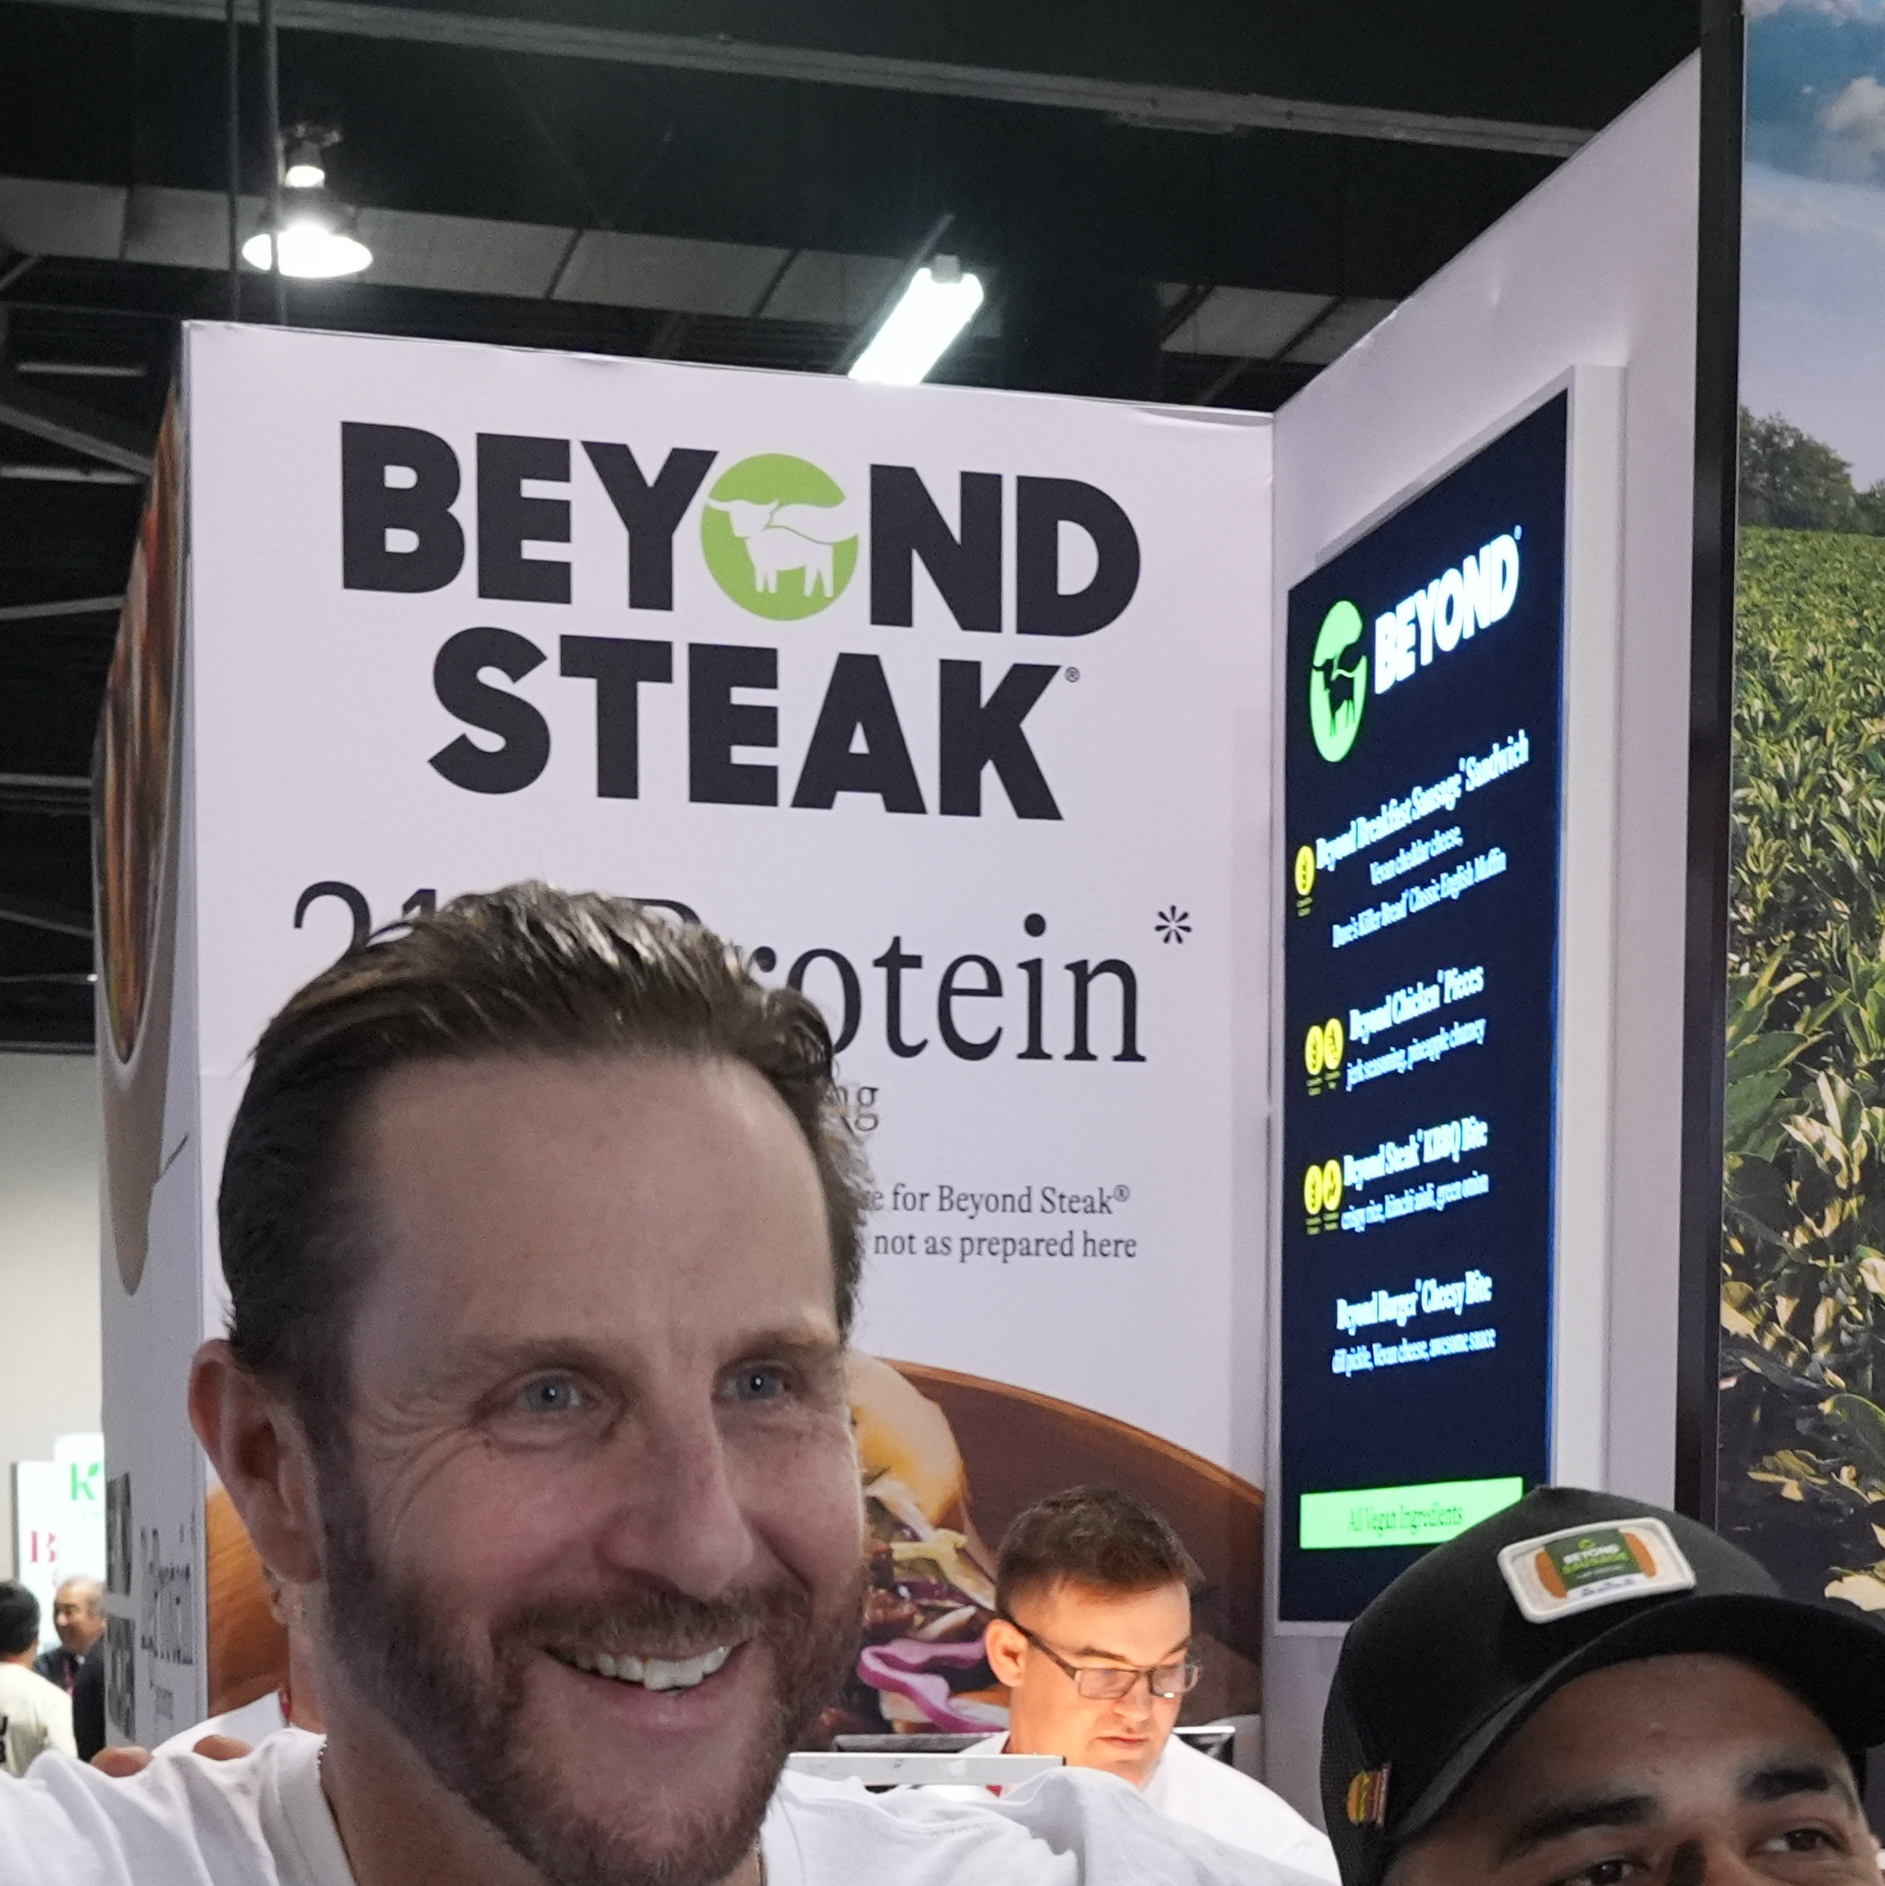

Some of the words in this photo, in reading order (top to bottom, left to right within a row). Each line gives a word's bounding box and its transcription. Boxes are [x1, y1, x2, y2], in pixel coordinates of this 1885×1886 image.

[340, 421, 1141, 638] BEYOND
[1375, 533, 1519, 695] BEYOND
[1315, 820, 1355, 872] Beyond
[1465, 729, 1529, 791] Sandwich
[1349, 995, 1391, 1044] Beyond
[1343, 1144, 1385, 1191] Beyond
[892, 1183, 930, 1212] for
[937, 1185, 1033, 1219] Beyond
[874, 1232, 917, 1256] not
[924, 1235, 951, 1256] as
[960, 1230, 1074, 1263] prepared
[1083, 1230, 1138, 1258] here
[1336, 1291, 1378, 1336] Beyond
[1348, 1506, 1364, 1533] All
[1365, 1500, 1396, 1539] Vegan
[1400, 1493, 1463, 1537] Ingredients
